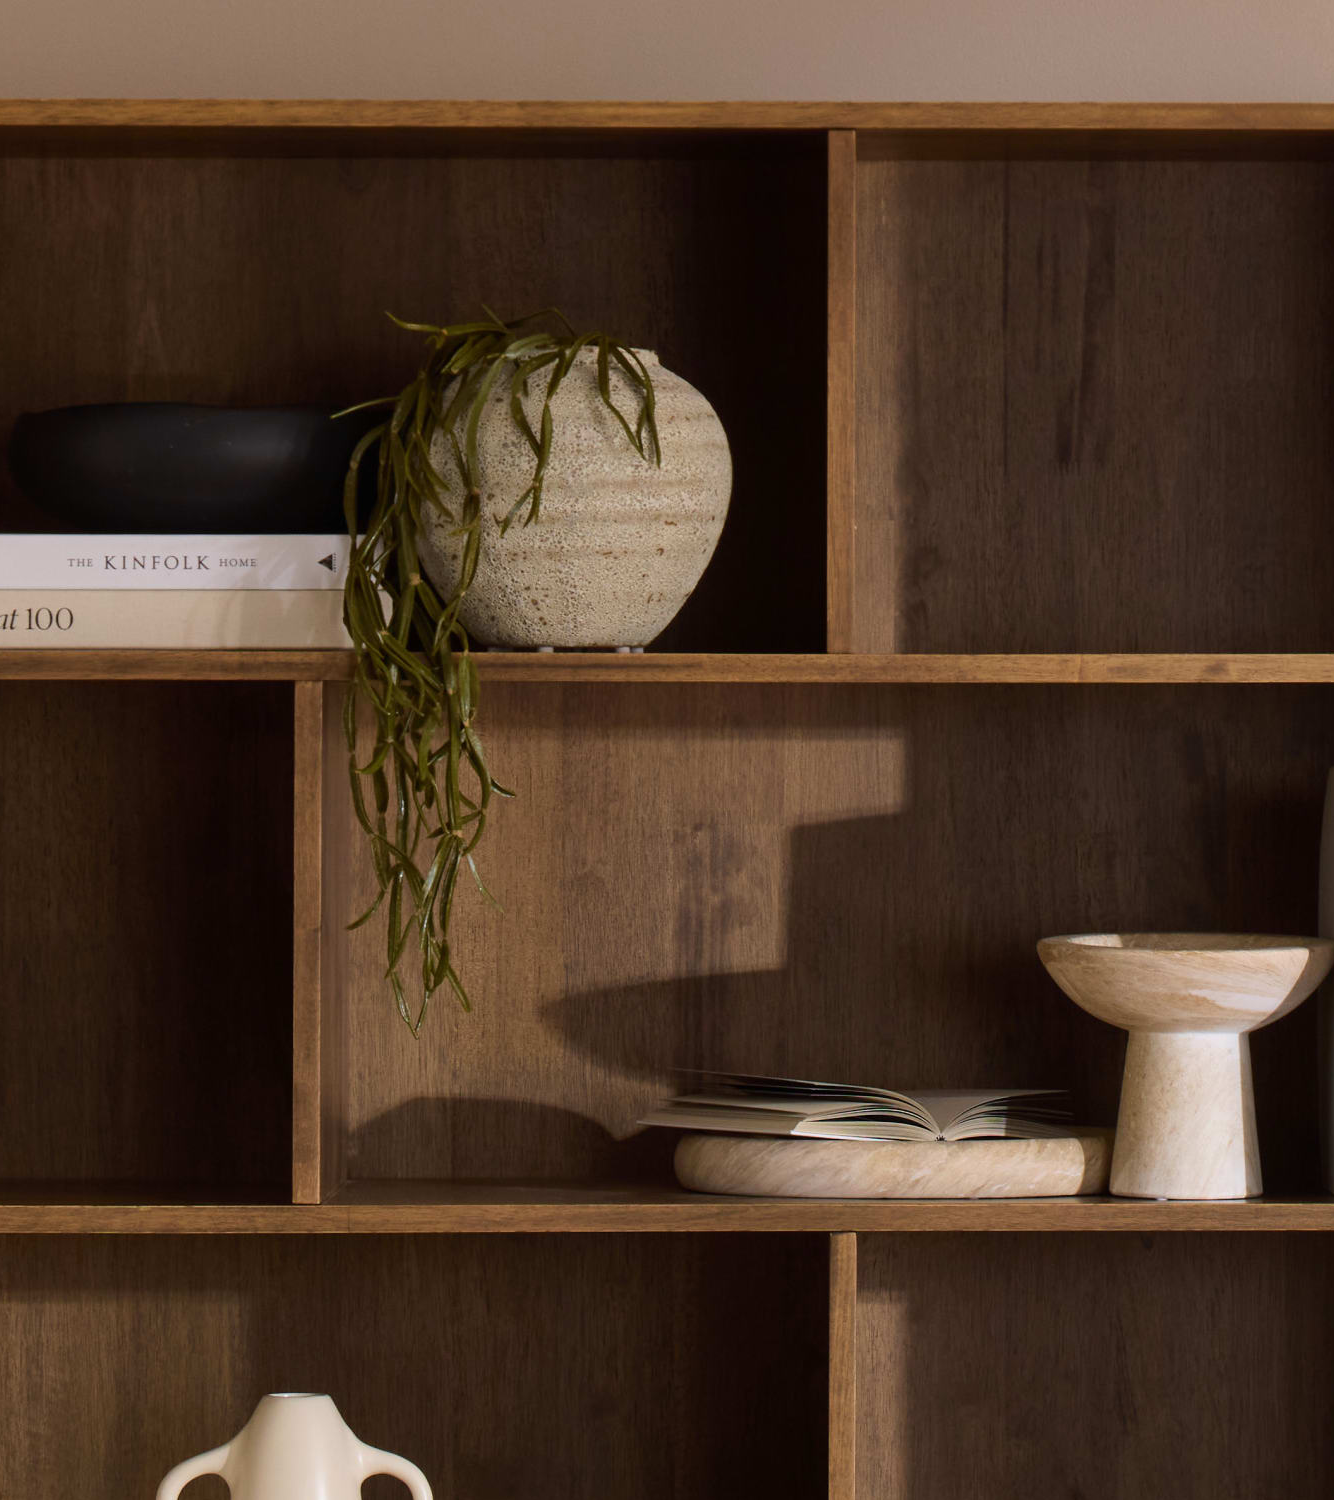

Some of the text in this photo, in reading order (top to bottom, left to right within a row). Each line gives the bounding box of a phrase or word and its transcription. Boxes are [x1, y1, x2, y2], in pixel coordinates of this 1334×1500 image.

[67, 555, 258, 570] THE KINFOLK HOME
[25, 607, 75, 632] 100
